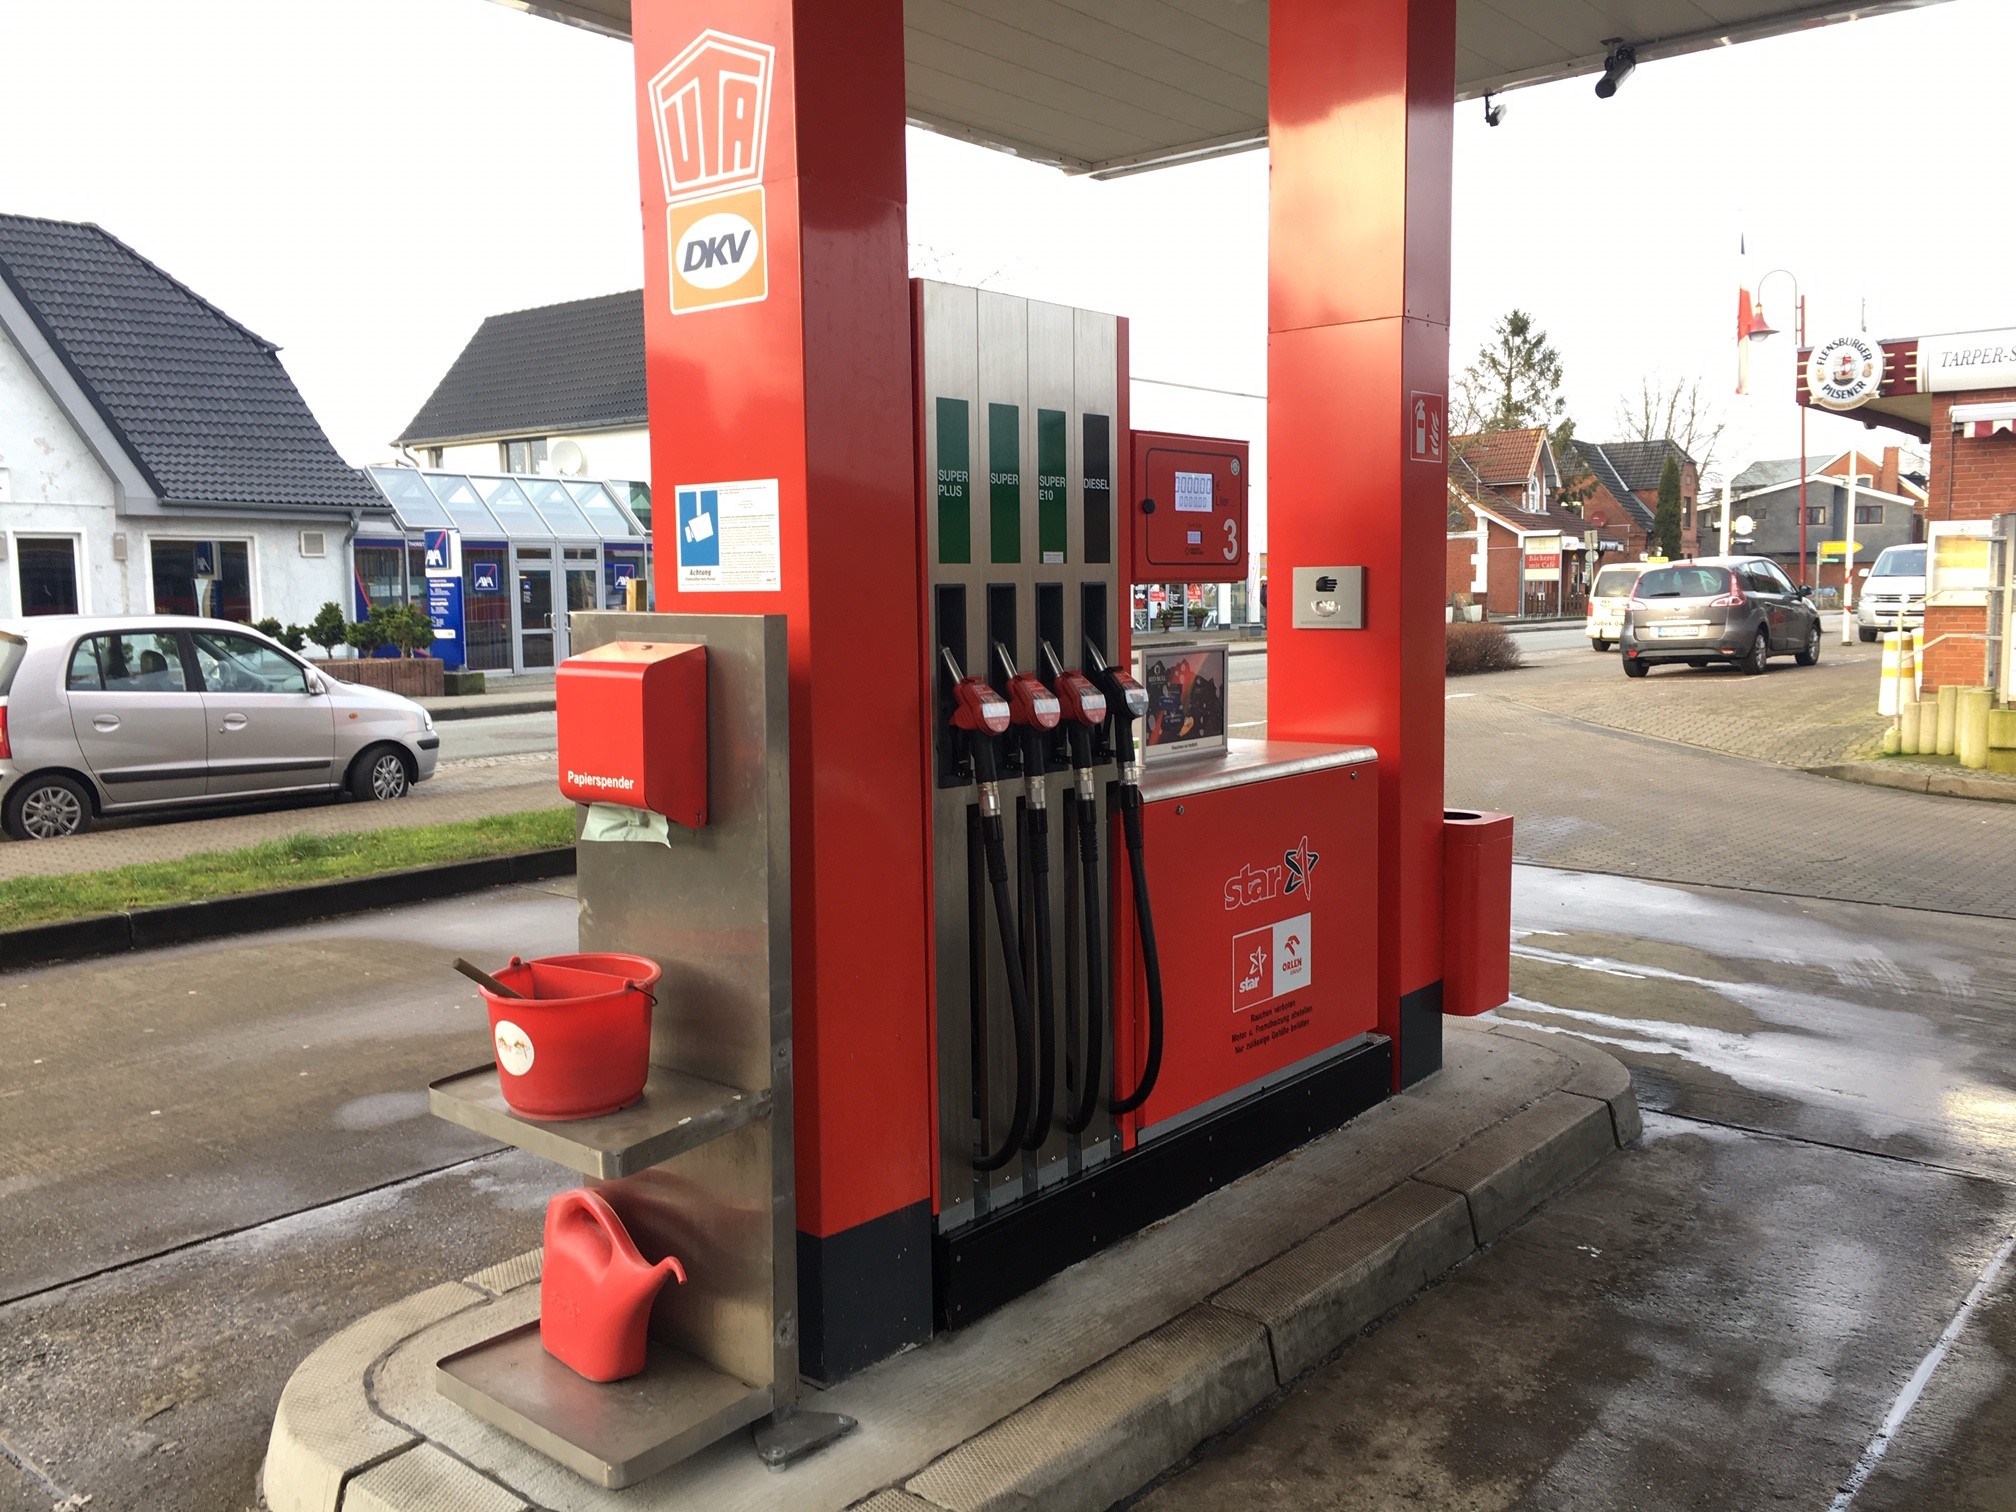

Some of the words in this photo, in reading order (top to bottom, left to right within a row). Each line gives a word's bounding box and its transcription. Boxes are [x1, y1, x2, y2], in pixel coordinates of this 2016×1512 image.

[660, 45, 763, 188] UTA
[682, 229, 752, 273] DKV
[1816, 337, 1873, 366] FLENSBURGER
[1822, 380, 1867, 400] PILSENER
[938, 469, 969, 483] SUPER
[990, 472, 1019, 486] SUPER
[1039, 475, 1066, 488] SUPER
[938, 484, 963, 498] PLUS
[1083, 478, 1110, 491] DIESEL
[1039, 488, 1054, 501] E10
[1222, 518, 1238, 561] 3
[425, 549, 443, 566] AXA
[689, 568, 712, 577] Achtung
[475, 576, 494, 588] AXA
[567, 770, 635, 790] Papierspender
[1225, 863, 1282, 910] star
[1282, 957, 1303, 972] ORLEN
[1238, 975, 1261, 994] star
[1250, 1008, 1272, 1023] Rauchen
[1274, 999, 1296, 1013] verboten
[1231, 1030, 1247, 1044] Motor
[1234, 1045, 1245, 1055] Nur
